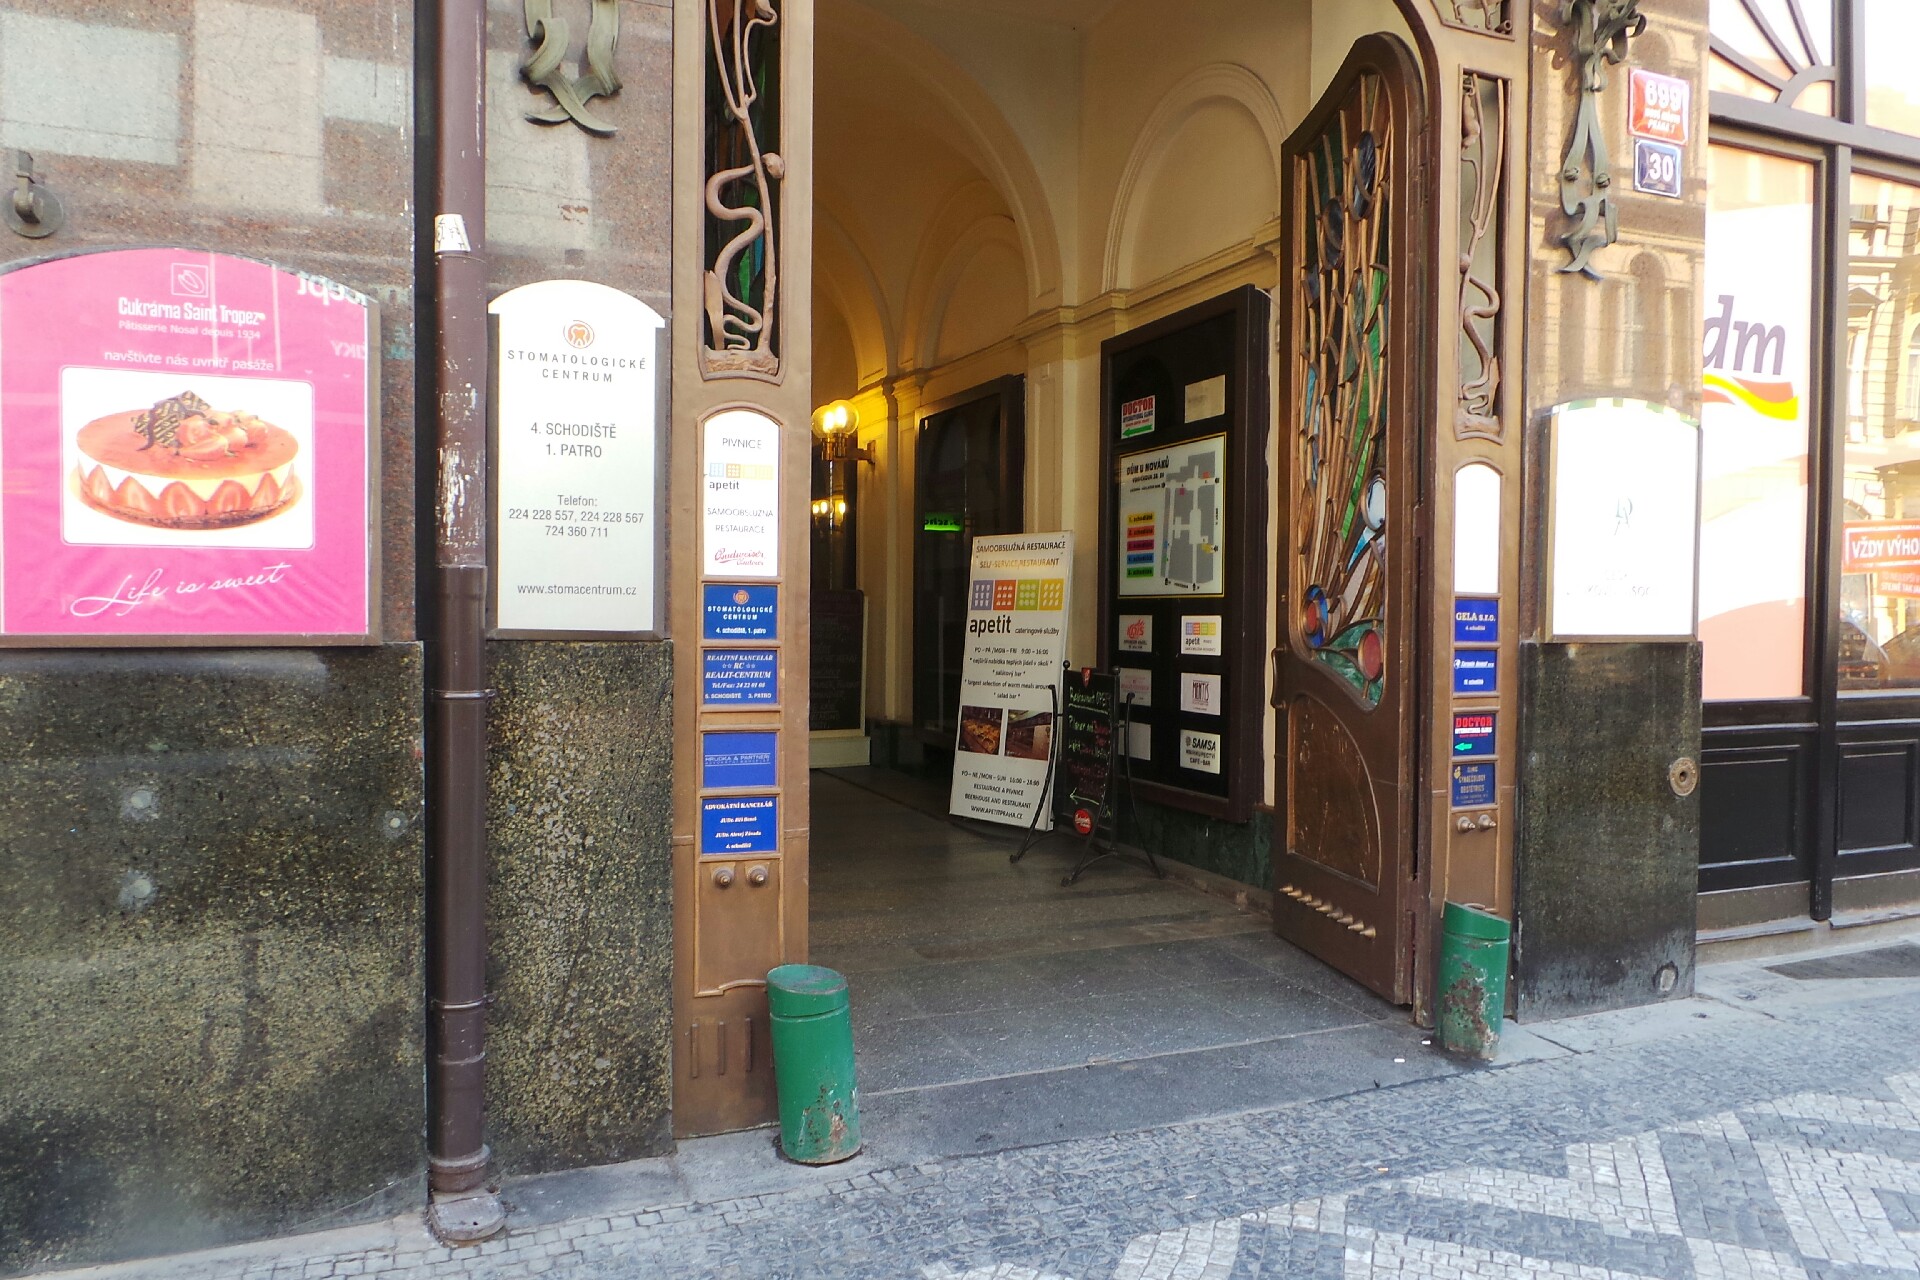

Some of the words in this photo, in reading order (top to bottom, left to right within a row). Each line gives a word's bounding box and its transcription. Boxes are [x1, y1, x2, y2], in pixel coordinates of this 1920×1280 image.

[1649, 152, 1675, 182] 30
[118, 297, 181, 319] Cukrárna
[183, 302, 218, 321] Saint
[220, 305, 261, 327] Tropez
[119, 320, 167, 333] Pâtisserie
[201, 327, 233, 338] depuis
[237, 329, 261, 339] 1934
[1702, 294, 1786, 375] dm
[166, 353, 189, 367] nás
[192, 357, 229, 369] uvnitř
[232, 358, 274, 371] pasáže
[507, 349, 646, 370] STOMATOLOGICKÉ
[542, 368, 612, 382] CENTRUM
[1122, 397, 1153, 417] DOCTOR
[530, 422, 542, 435] 4.
[546, 422, 617, 439] SCHODIŠTĚ
[722, 437, 762, 449] PIVNICE
[546, 443, 556, 456] 1.
[560, 443, 603, 458] PATRO
[709, 480, 740, 491] apetit
[557, 494, 598, 507] Telefon:
[509, 508, 529, 520] 224
[532, 509, 552, 521] 228
[580, 511, 600, 522] 224
[603, 512, 622, 523] 228
[625, 513, 645, 524] 567
[545, 525, 565, 537] 724
[567, 526, 587, 538] 360
[590, 526, 608, 538] 711
[976, 541, 1026, 554] SAMOOBSLUŽNÁ
[1026, 541, 1066, 551] RESTAURACE
[1851, 535, 1884, 558] VŽDY
[1886, 533, 1920, 556] VÝHO
[70, 568, 168, 617] Life
[175, 580, 206, 594] is
[208, 562, 292, 590] sweet
[517, 584, 637, 596] www.stomacentrum.cz
[707, 605, 773, 613] STOMATOLOGICKÉ
[1455, 612, 1478, 621] GELA
[1478, 614, 1496, 622] s.r.o.
[969, 614, 1011, 637] apetit
[1185, 637, 1200, 647] apetit
[705, 671, 771, 679] REALIT-CENTRUM
[1455, 716, 1493, 728] DOCTOR
[1192, 737, 1216, 752] SAMSA
[973, 783, 1001, 793] RESTAURACE
[1001, 799, 1032, 809] RESTAURANT
